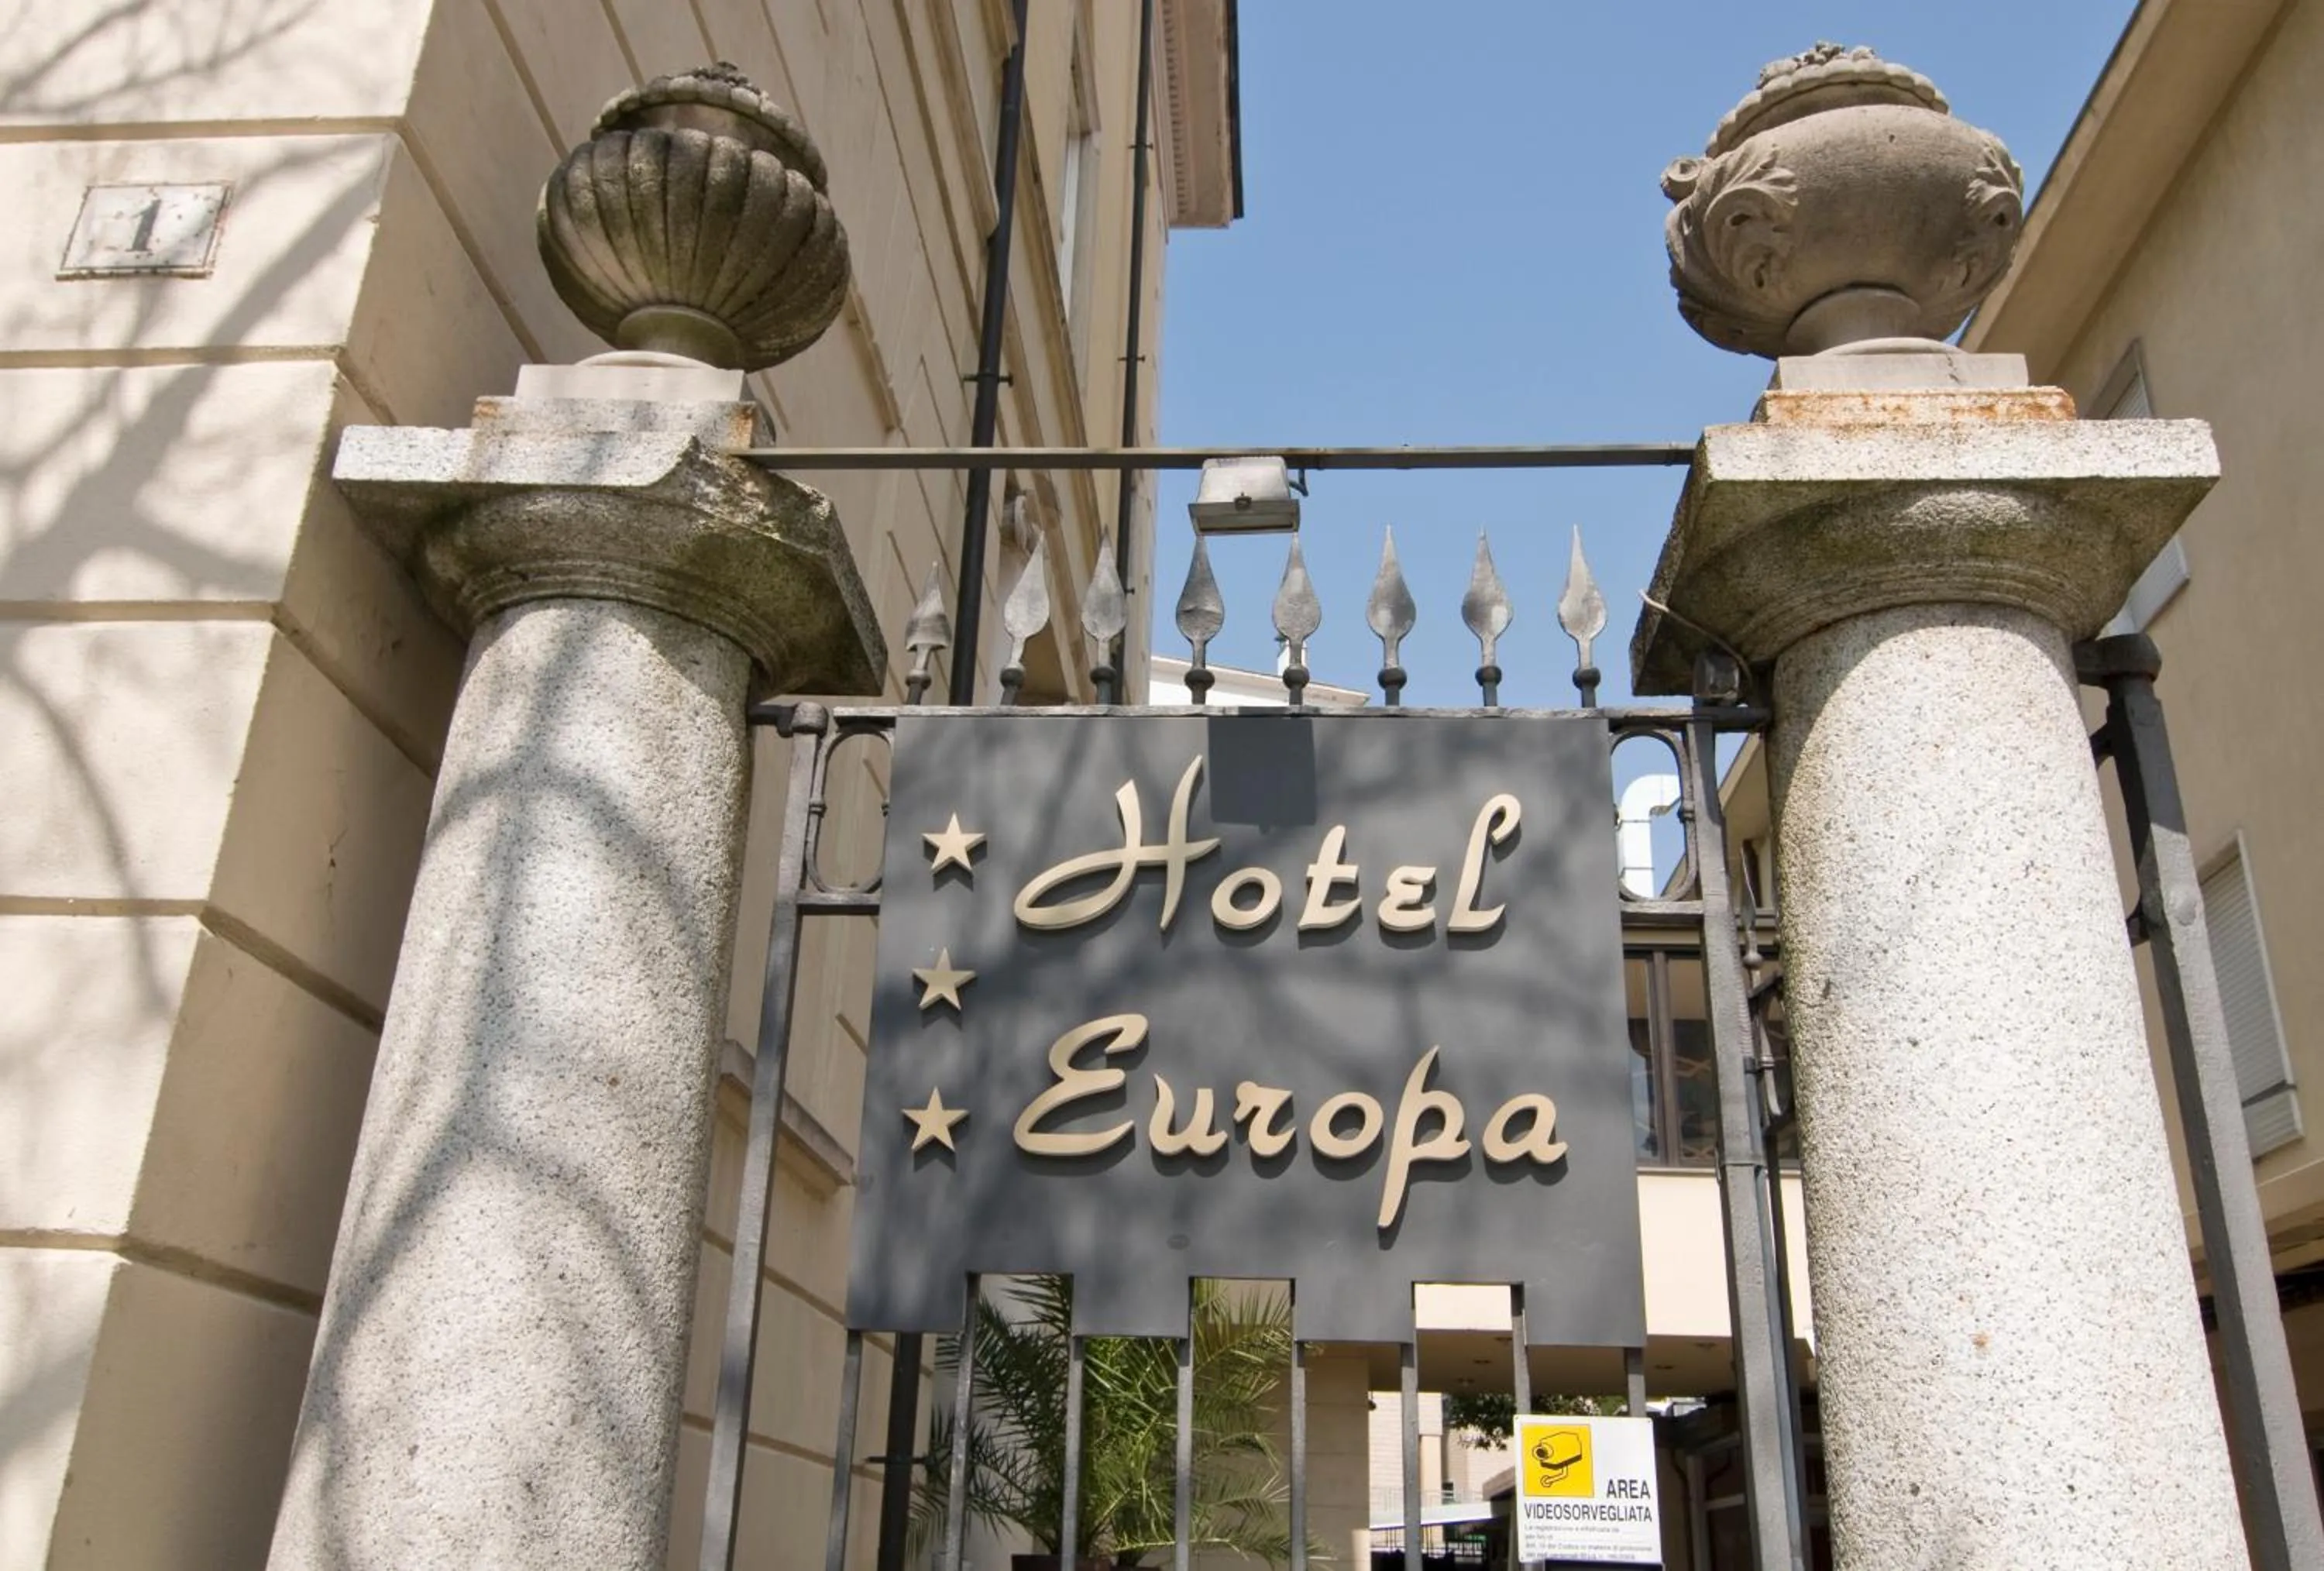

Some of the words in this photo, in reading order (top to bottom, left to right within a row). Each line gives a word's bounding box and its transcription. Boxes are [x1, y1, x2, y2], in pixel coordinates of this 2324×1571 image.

[125, 198, 161, 252] 1
[1013, 754, 1521, 933] Hotel
[1013, 1012, 1569, 1230] Europa
[1524, 1502, 1652, 1522] VIDEOSORVEGLIATA
[1606, 1478, 1651, 1499] AREA
